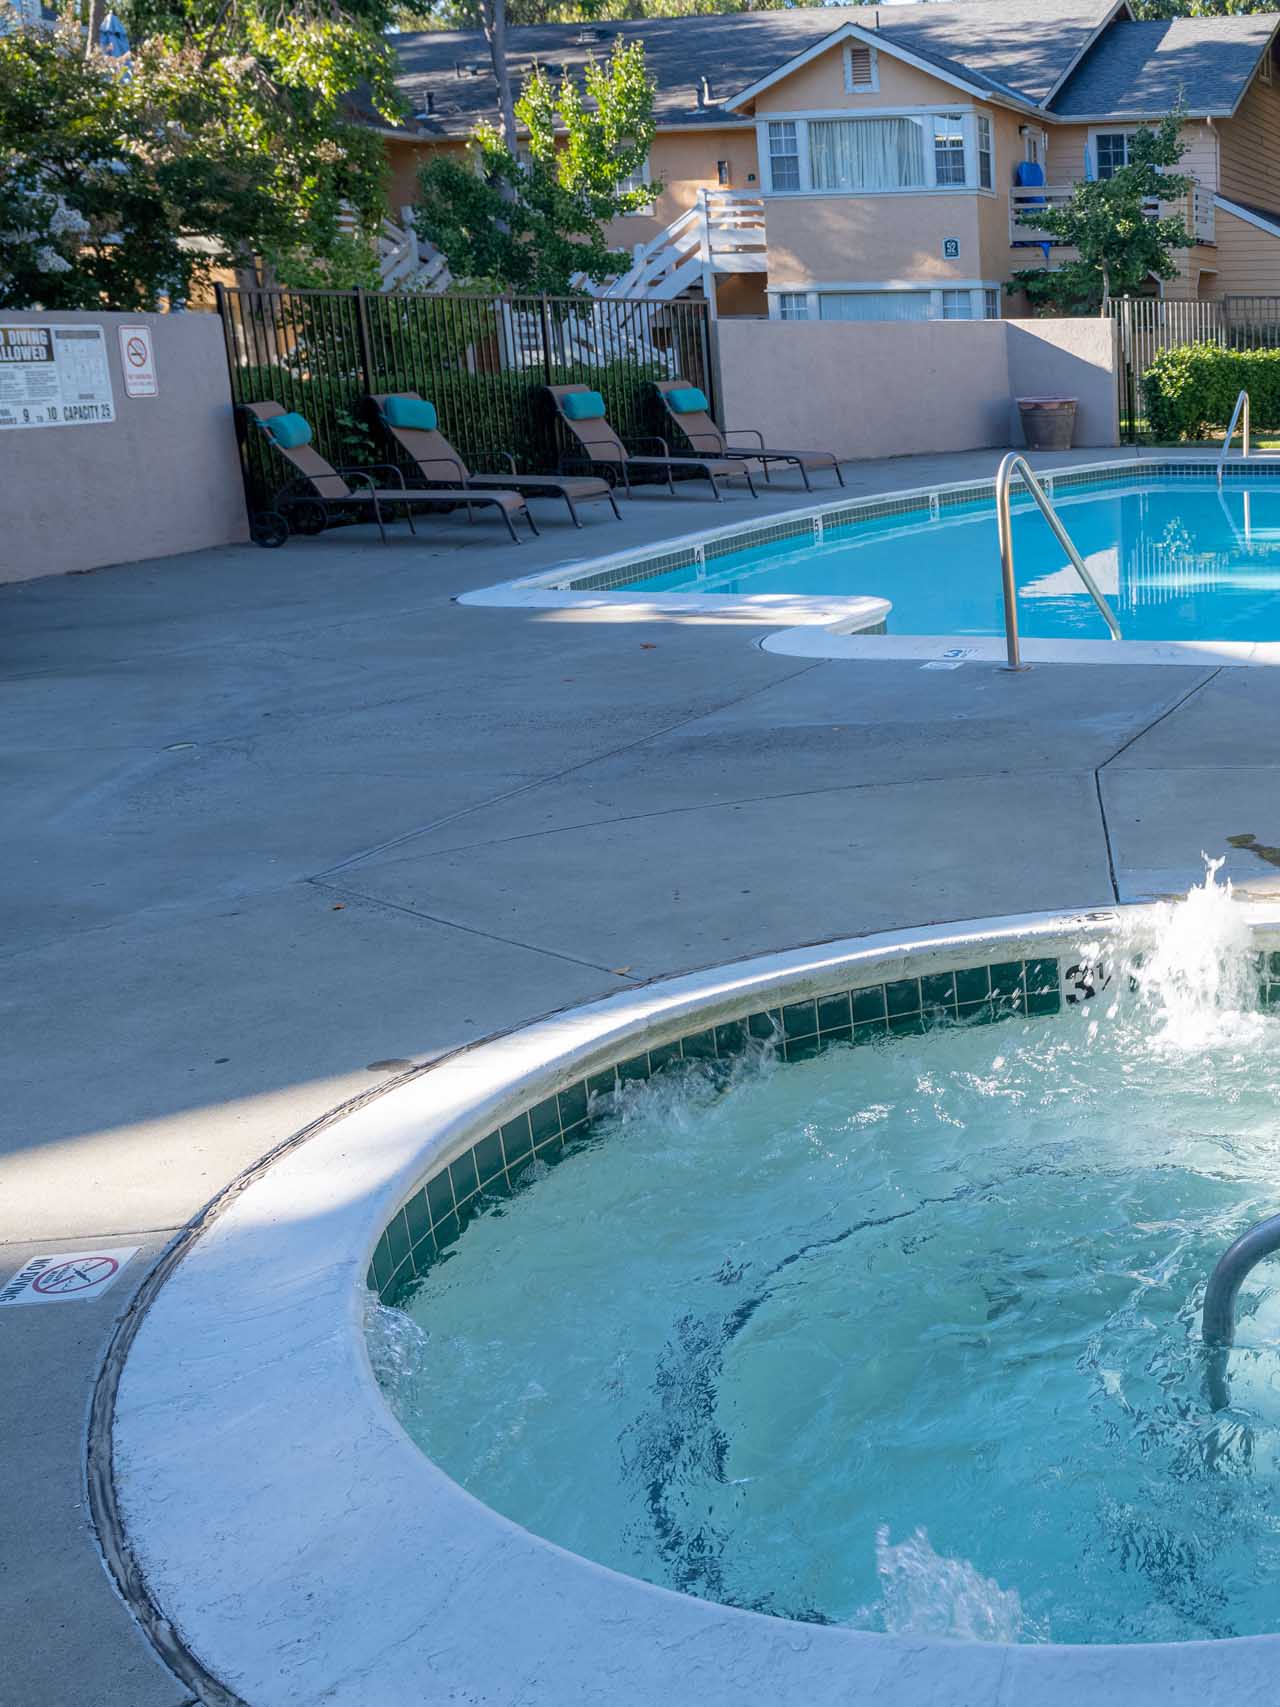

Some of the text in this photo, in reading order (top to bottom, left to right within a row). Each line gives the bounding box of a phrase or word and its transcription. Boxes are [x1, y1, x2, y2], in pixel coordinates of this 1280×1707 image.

[946, 242, 956, 253] 52
[8, 331, 48, 345] DIVING
[0, 346, 47, 360] LLOWED
[23, 408, 29, 422] 9
[46, 406, 57, 420] 10
[63, 405, 98, 420] CAPACITY
[101, 404, 110, 417] 25
[1065, 964, 1096, 1004] 3
[0, 1258, 53, 1302] NO DIVING
